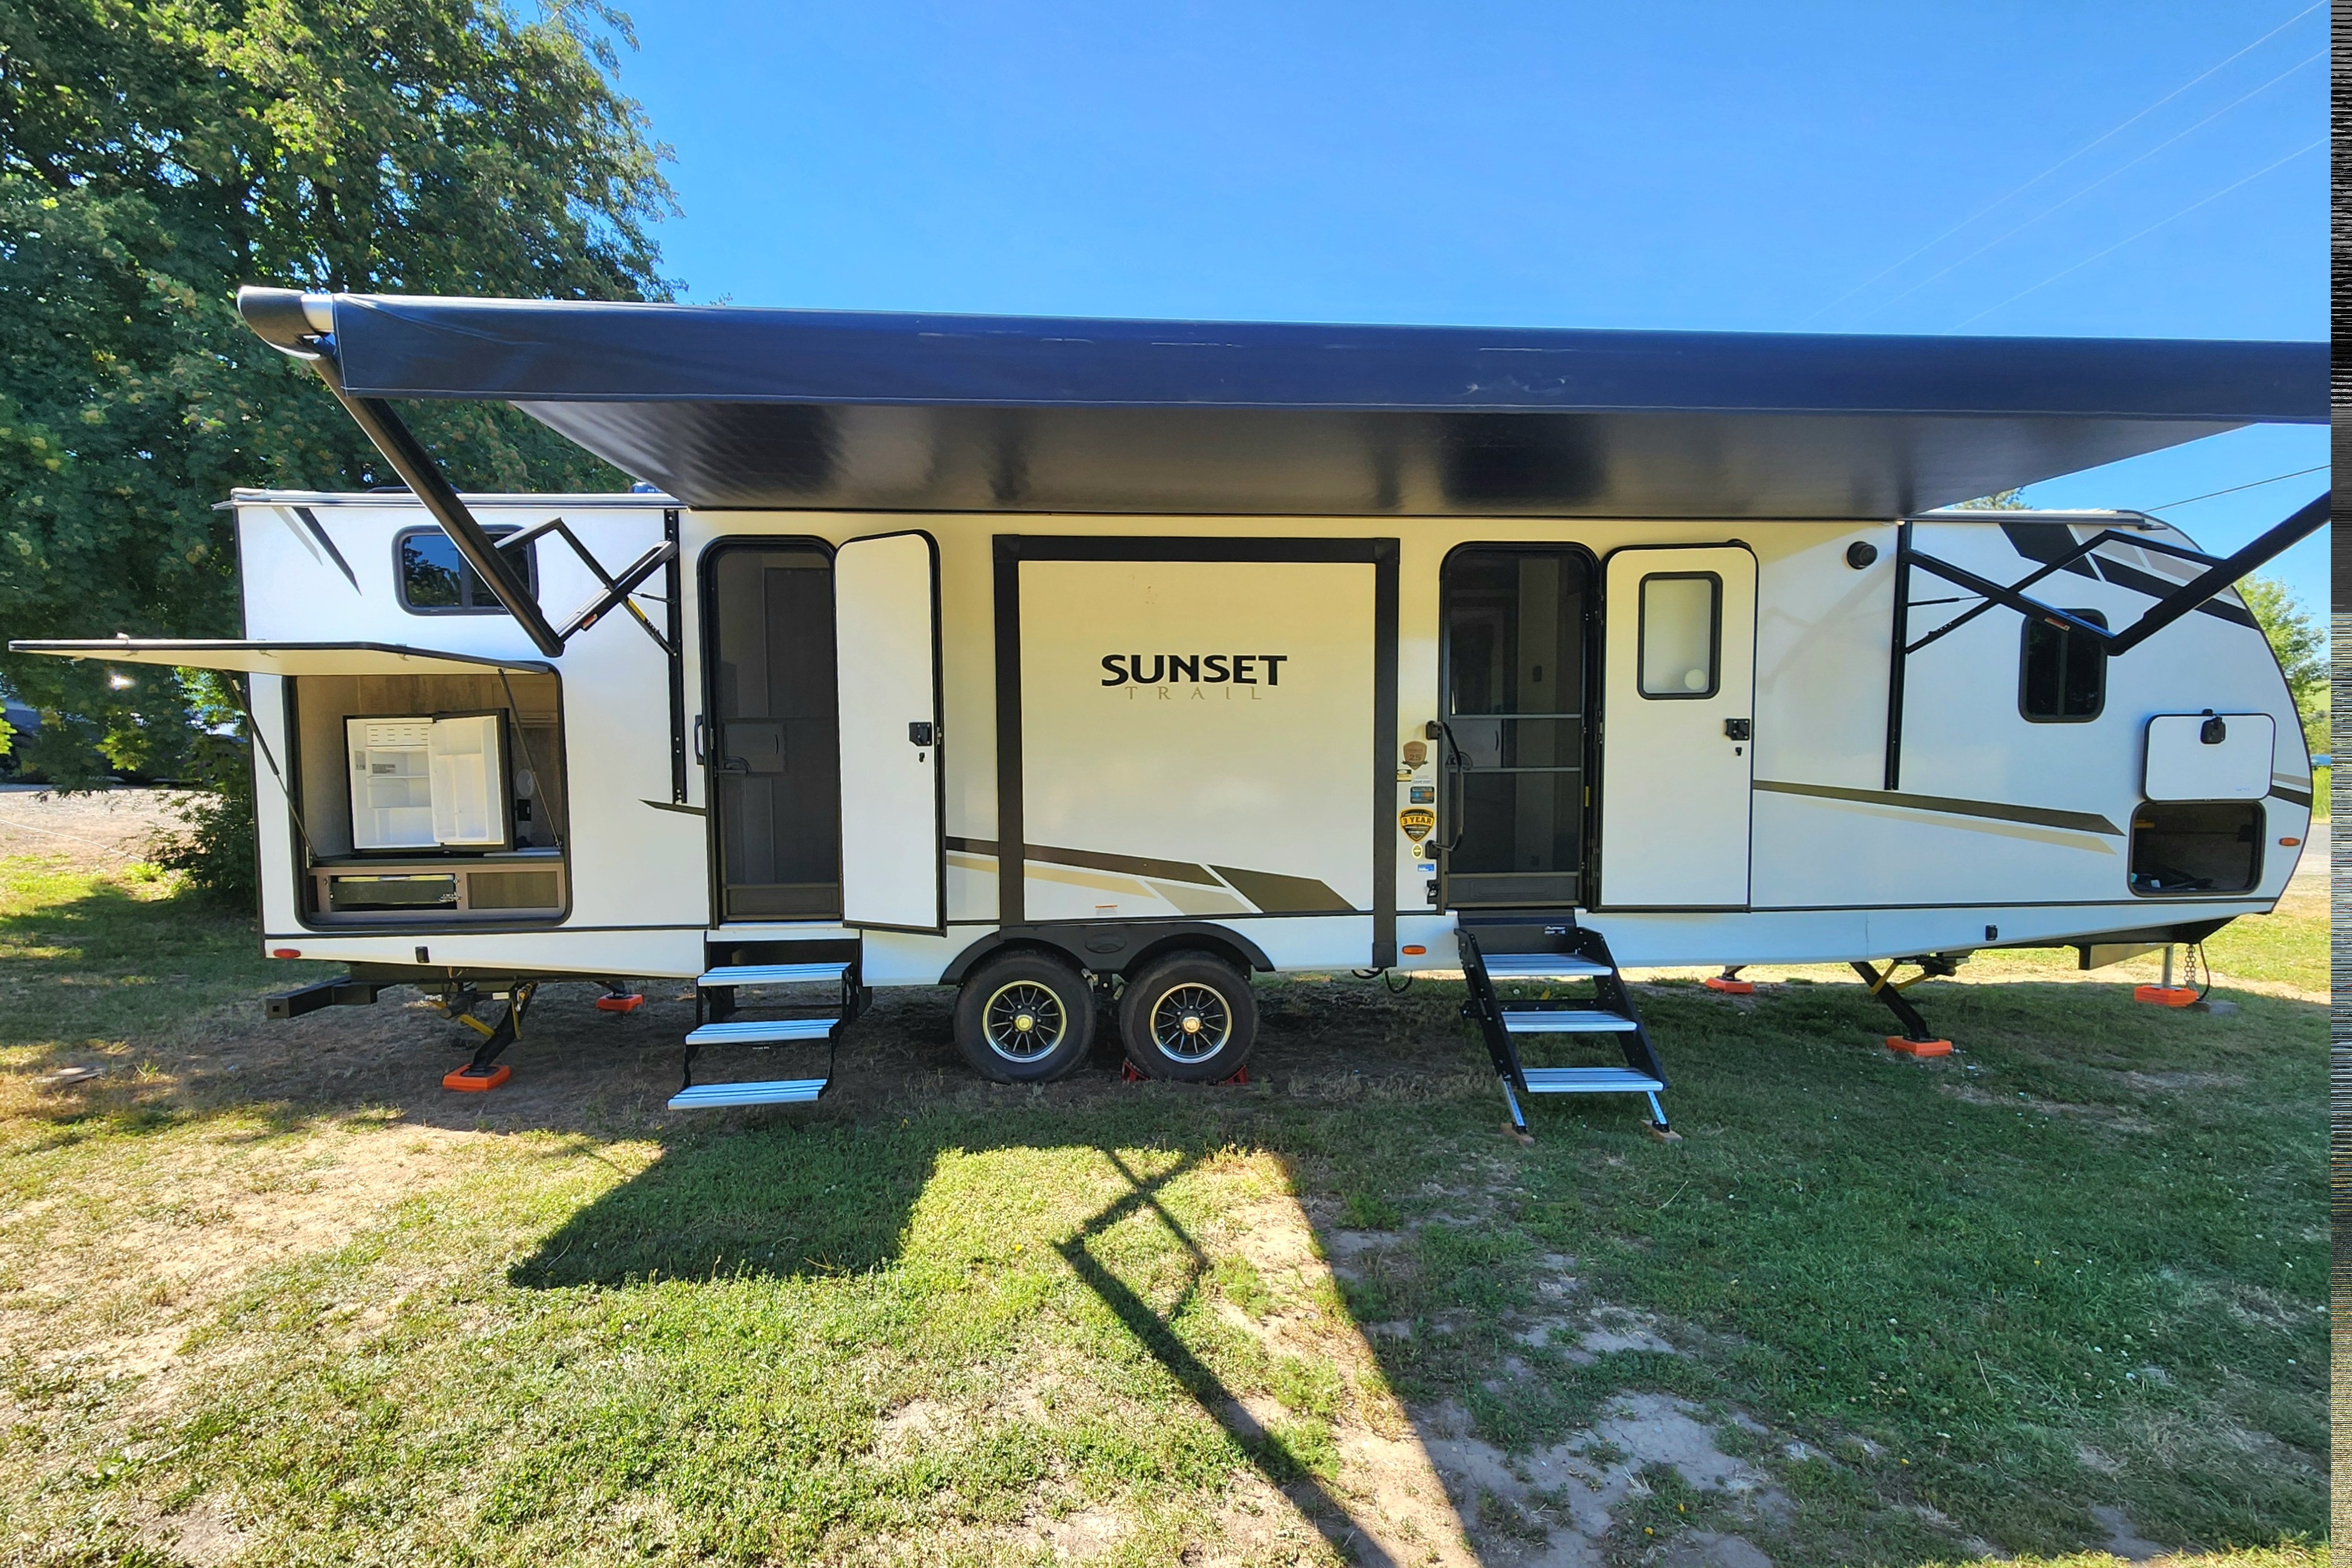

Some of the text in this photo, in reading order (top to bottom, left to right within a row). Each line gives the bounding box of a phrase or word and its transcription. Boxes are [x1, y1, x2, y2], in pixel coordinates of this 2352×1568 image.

[1101, 654, 1288, 686] SUNSET
[1125, 686, 1262, 700] TRAIL
[1409, 816, 1432, 825] YEAR
